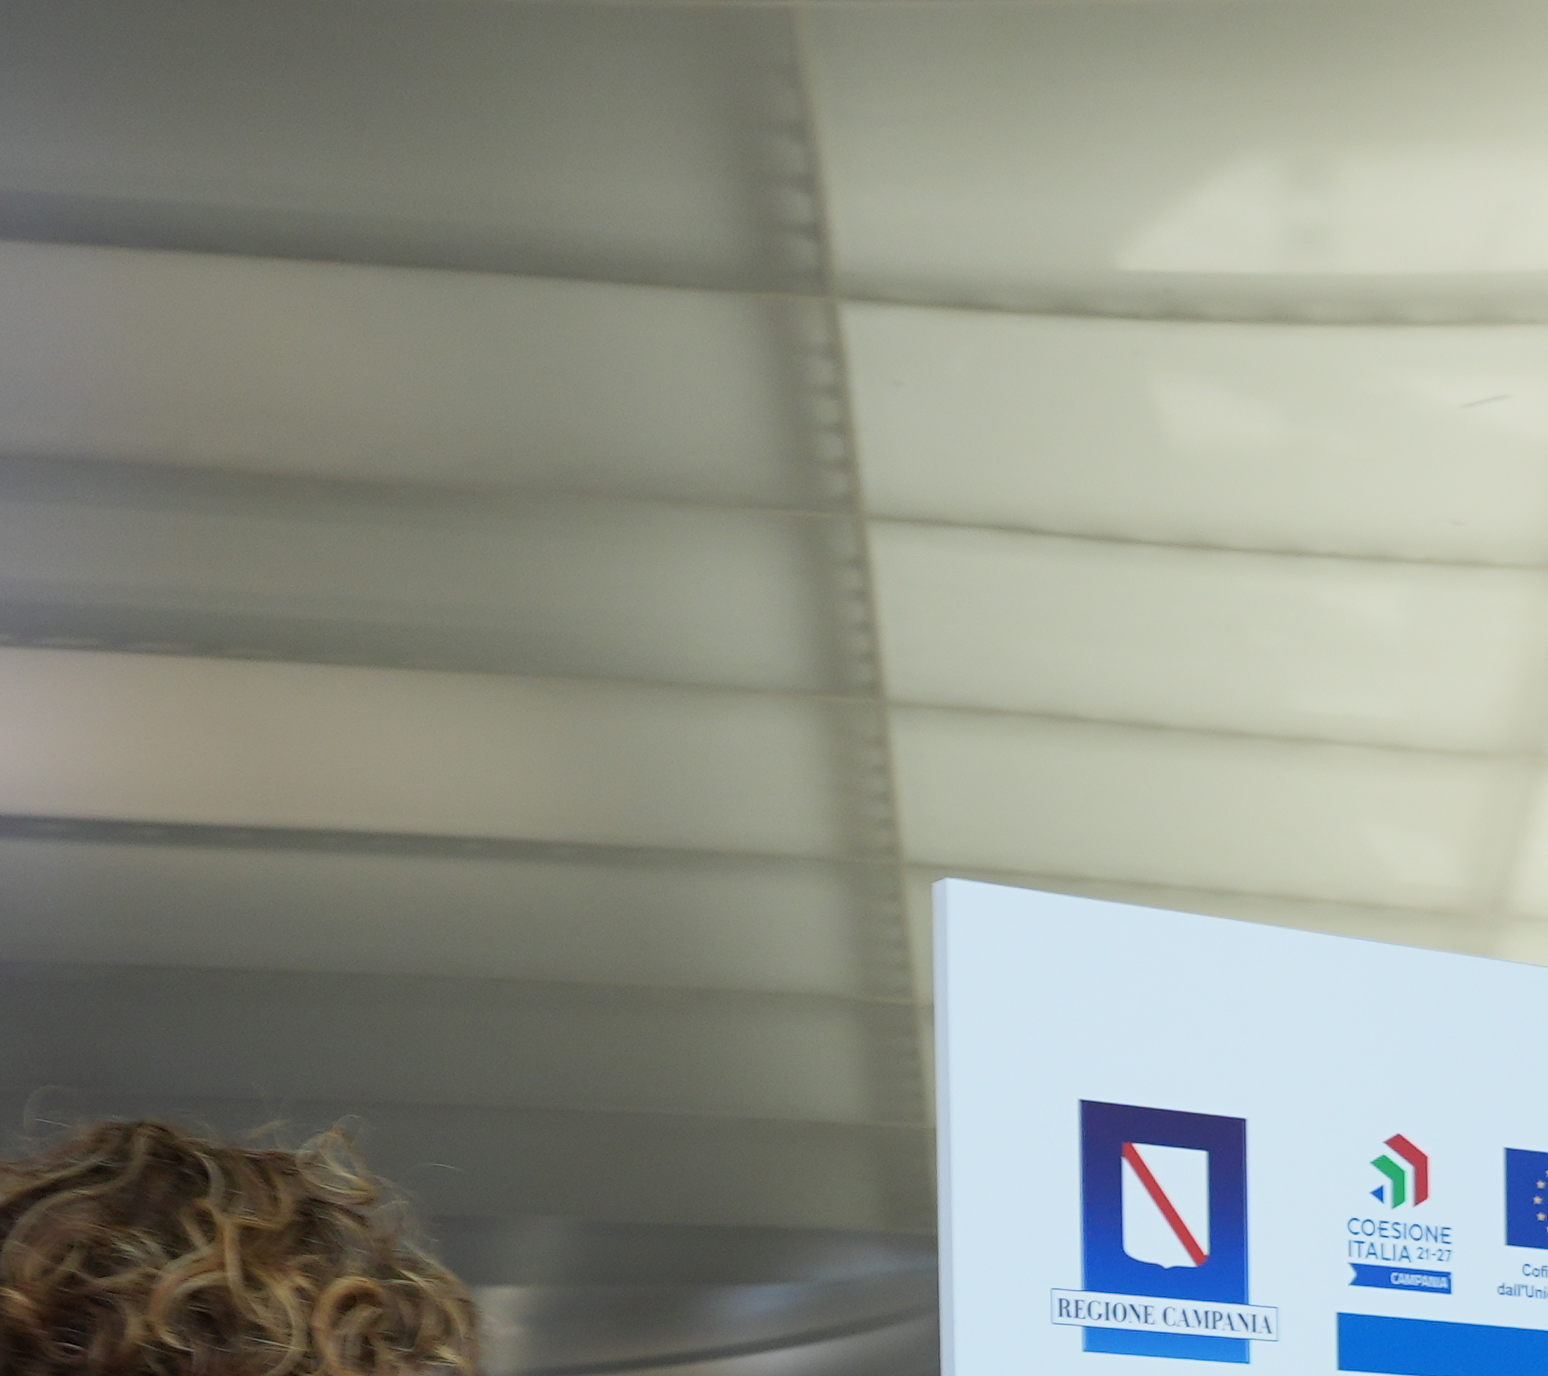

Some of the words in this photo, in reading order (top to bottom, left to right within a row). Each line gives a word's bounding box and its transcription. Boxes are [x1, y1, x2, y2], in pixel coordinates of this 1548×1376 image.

[1347, 1217, 1452, 1244] COESIONE
[1348, 1240, 1411, 1262] ITALIA
[1416, 1247, 1451, 1262] 21-27
[1390, 1272, 1448, 1289] CAMPANIA
[1058, 1298, 1155, 1325] REGIONE
[1162, 1306, 1273, 1335] CAMPANIA
